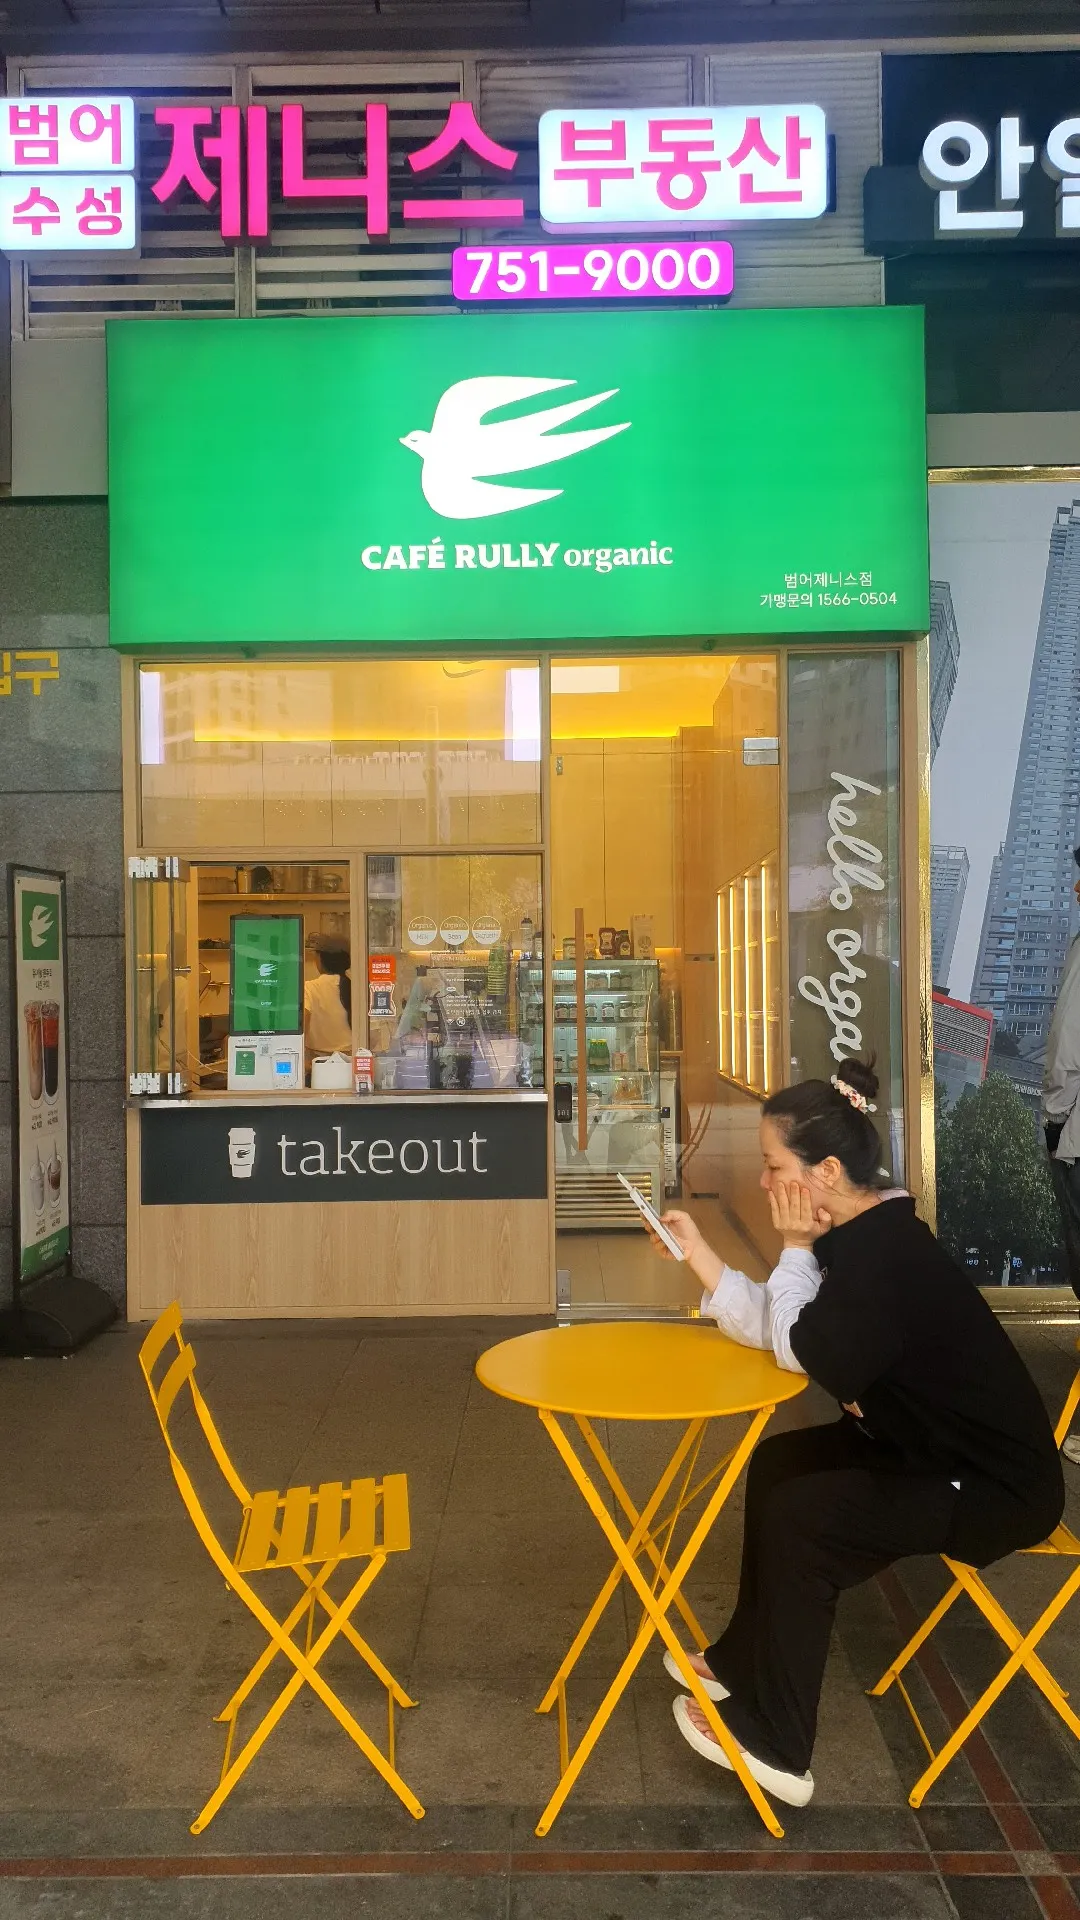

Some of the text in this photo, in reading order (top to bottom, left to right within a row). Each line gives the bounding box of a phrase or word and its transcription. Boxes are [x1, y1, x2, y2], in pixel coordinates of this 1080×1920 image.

[8, 103, 122, 165] 범어
[150, 101, 812, 238] 제니스 부동산
[12, 187, 123, 236] 수성
[465, 246, 721, 295] 751-9000
[361, 537, 674, 573] CAFÉ RULLY organic
[784, 571, 873, 588] 범어제니스점
[760, 592, 898, 608] 가맹문의 1566-0504
[798, 771, 884, 1064] hello orga
[277, 1126, 488, 1177] takeout
